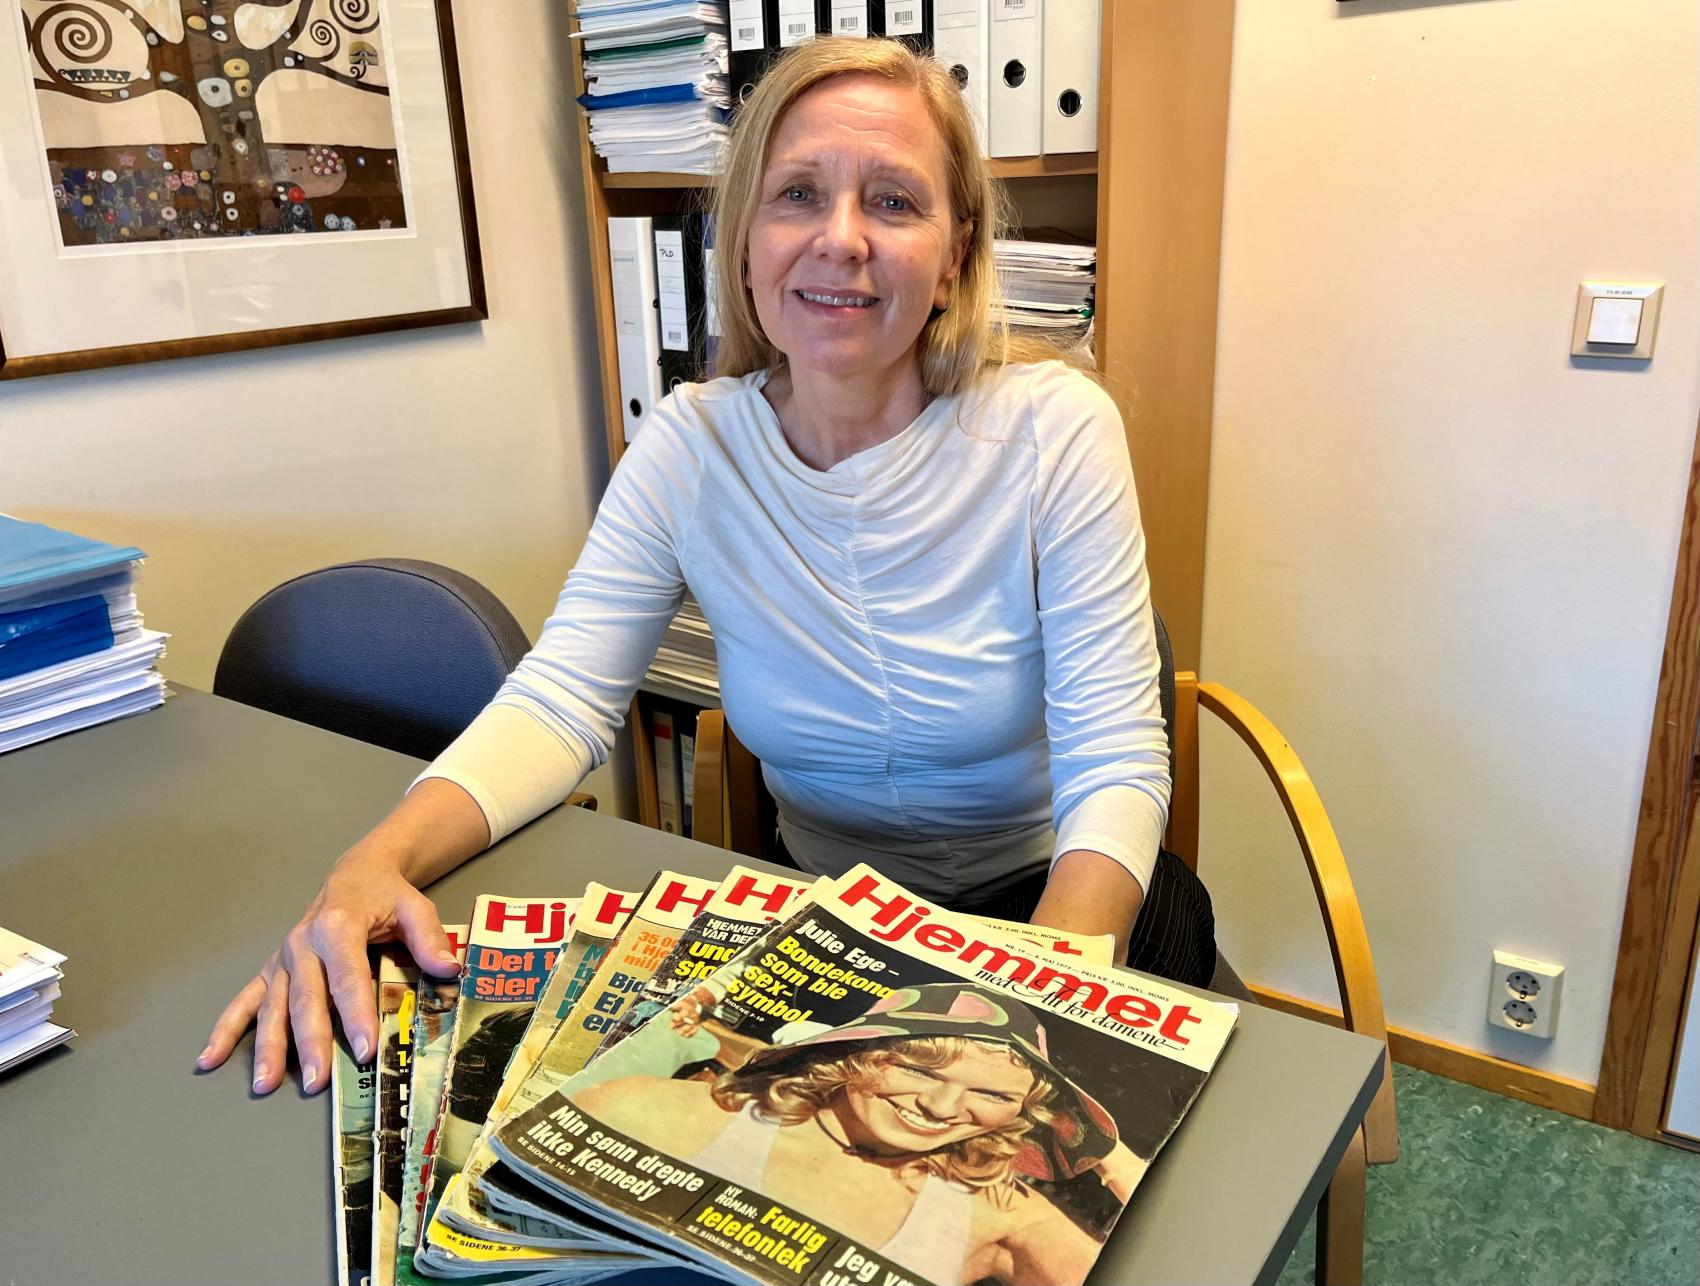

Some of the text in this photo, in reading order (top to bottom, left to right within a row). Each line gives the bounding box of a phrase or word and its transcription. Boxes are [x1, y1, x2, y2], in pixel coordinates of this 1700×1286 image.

[702, 927, 728, 941] VAR
[795, 919, 845, 954] Julie
[844, 947, 887, 972] Ege
[479, 948, 535, 972] Det
[760, 952, 849, 1000] som ble
[838, 874, 1202, 1046] Hjemmet
[475, 974, 541, 996] sier
[744, 965, 794, 998] sex-
[594, 991, 625, 1015] Et
[726, 978, 813, 1024] symbol
[974, 969, 1013, 989] med
[1051, 1001, 1094, 1019] for
[1091, 1013, 1186, 1051] damene
[517, 1137, 528, 1147] SE
[527, 1142, 556, 1164] SIDENE
[527, 1120, 663, 1202] ikke Kennedy
[549, 1105, 705, 1192] Min sønn drepte
[714, 1194, 758, 1219] ROMAN:
[724, 1185, 743, 1198] NY
[459, 1239, 494, 1251] SIDENE
[686, 1224, 700, 1235] SE
[699, 1231, 733, 1251] SIDENE
[696, 1206, 811, 1274] telefonlek
[760, 1206, 828, 1254] Farlig
[834, 1245, 880, 1283] Jeg
